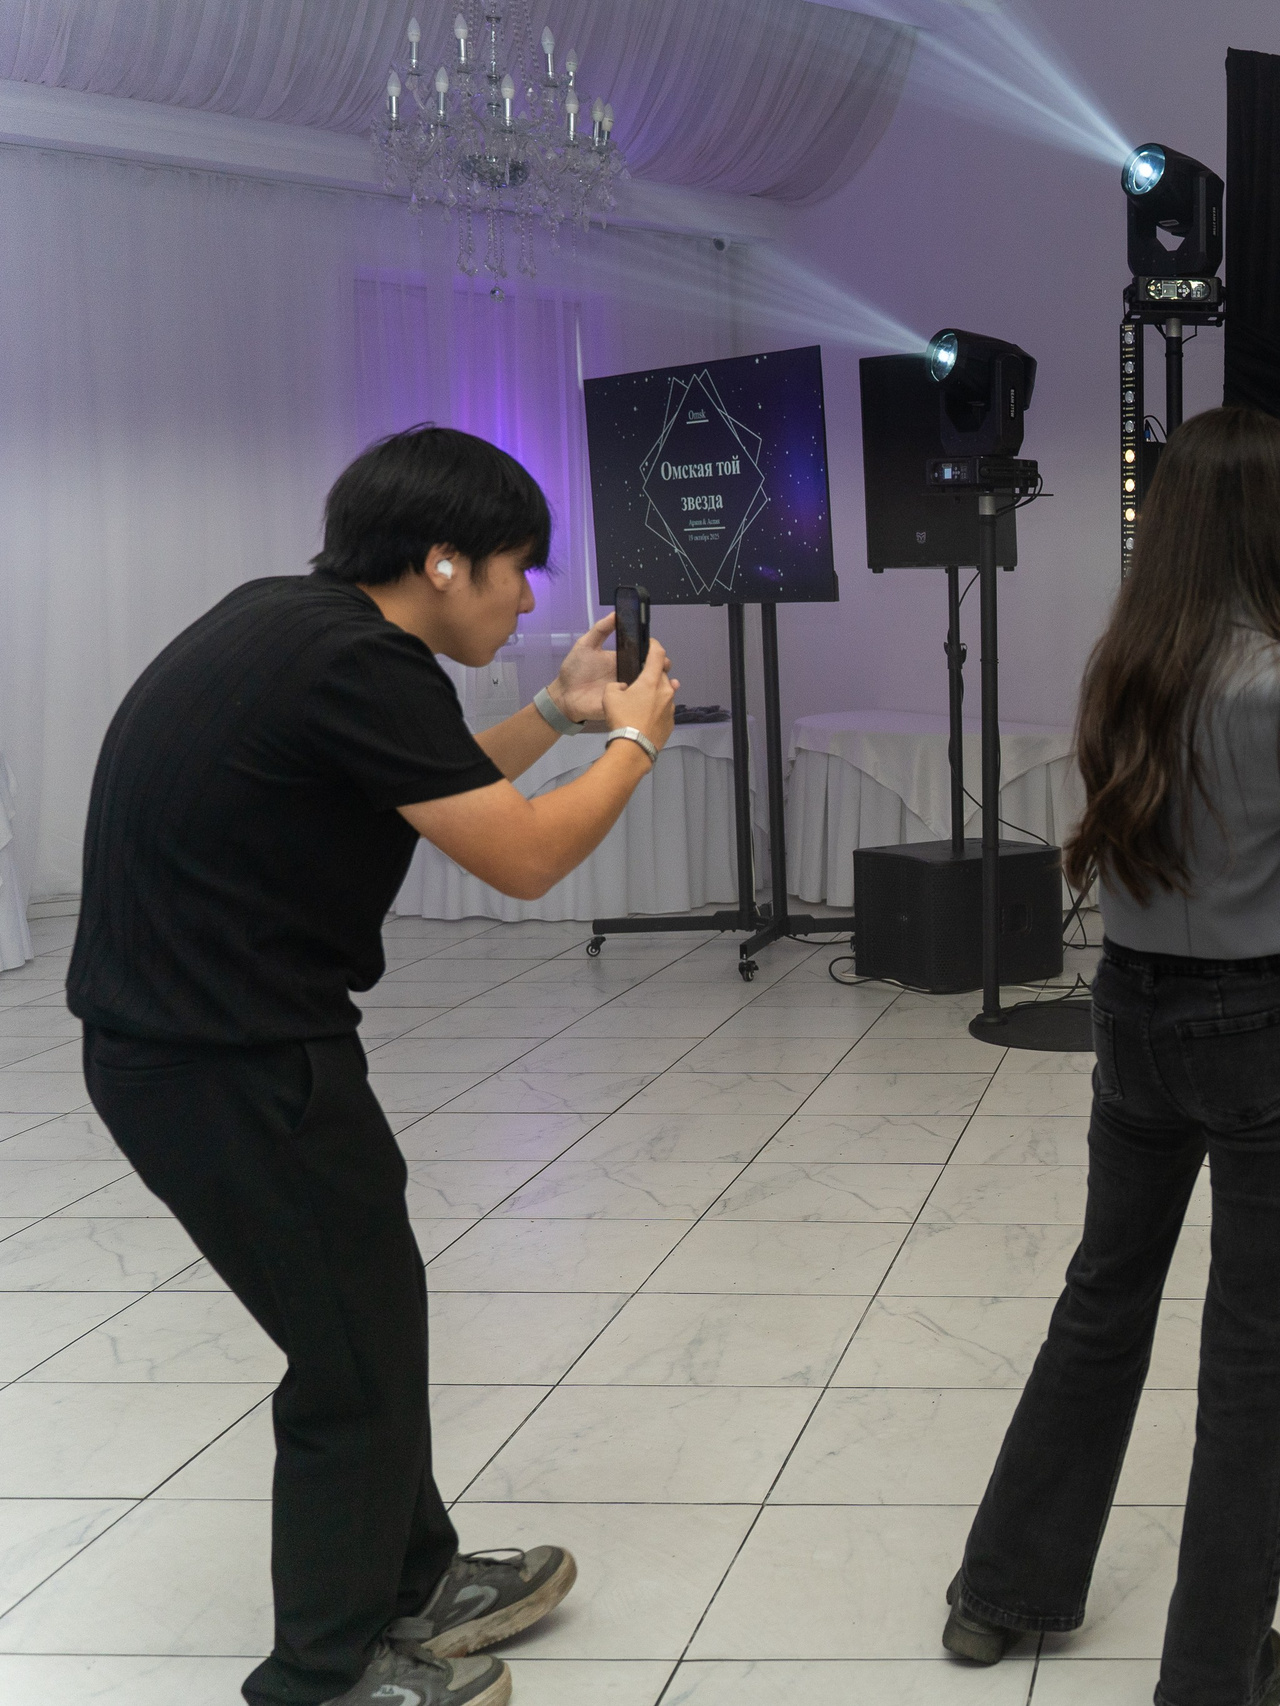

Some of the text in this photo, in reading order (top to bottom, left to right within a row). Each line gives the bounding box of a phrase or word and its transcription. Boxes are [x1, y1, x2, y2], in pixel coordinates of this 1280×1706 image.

[688, 409, 706, 420] Omsk
[660, 455, 741, 481] Омская той
[680, 494, 724, 512] звезда
